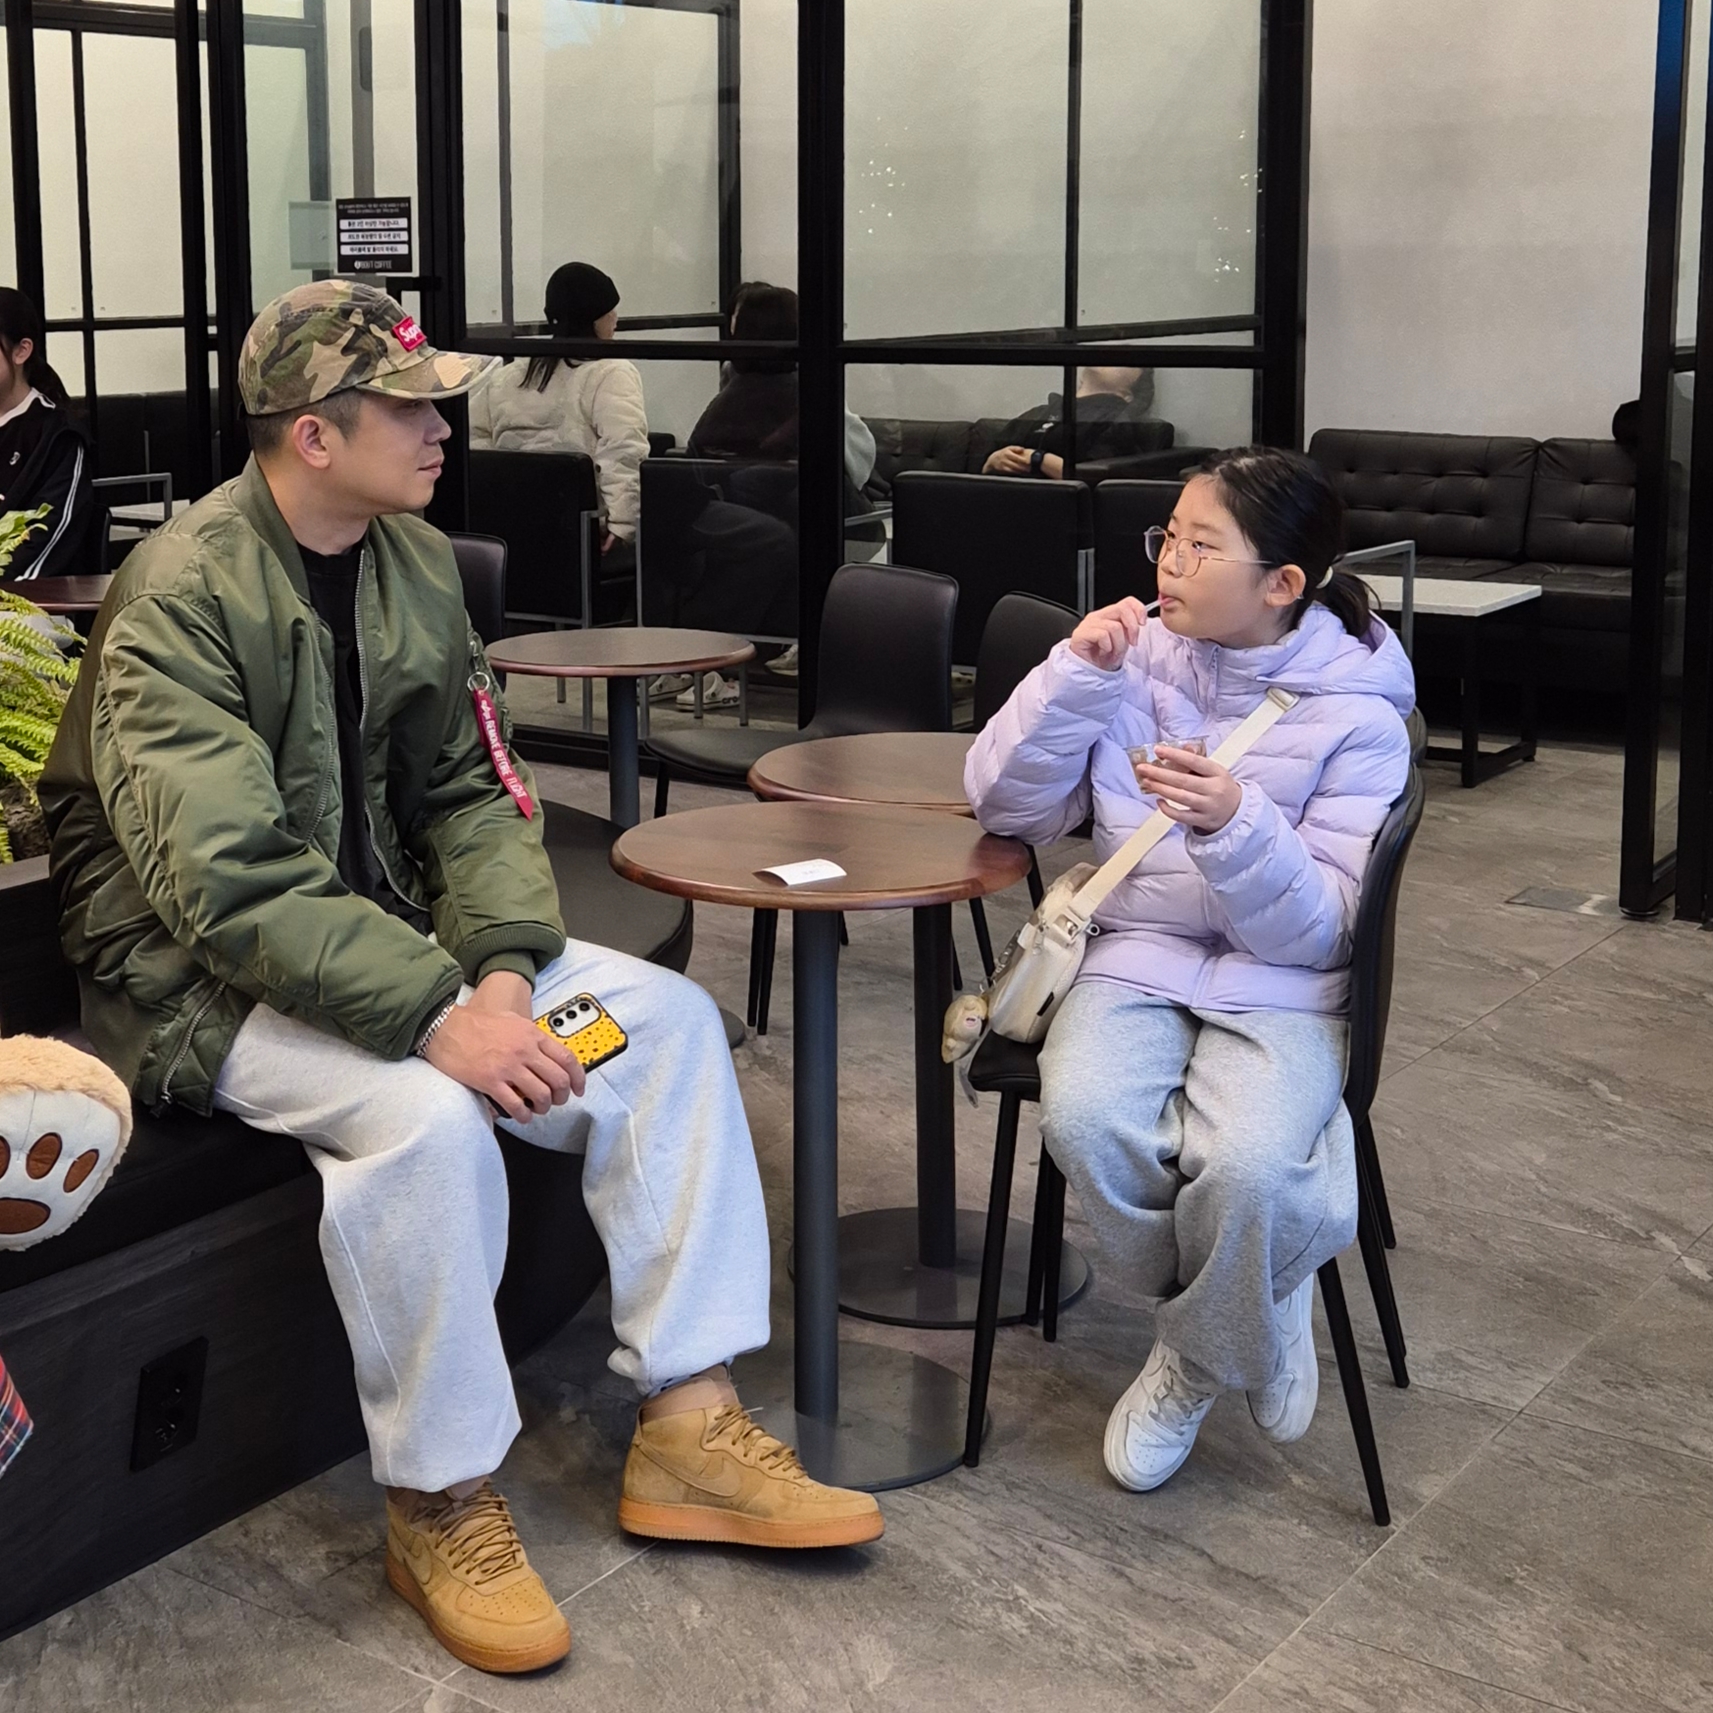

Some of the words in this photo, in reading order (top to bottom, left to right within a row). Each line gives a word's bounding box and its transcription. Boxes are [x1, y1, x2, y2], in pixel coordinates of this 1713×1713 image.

[486, 720, 500, 750] REMOVE
[494, 750, 512, 776] BEFORE
[506, 777, 527, 798] FLIGHT
